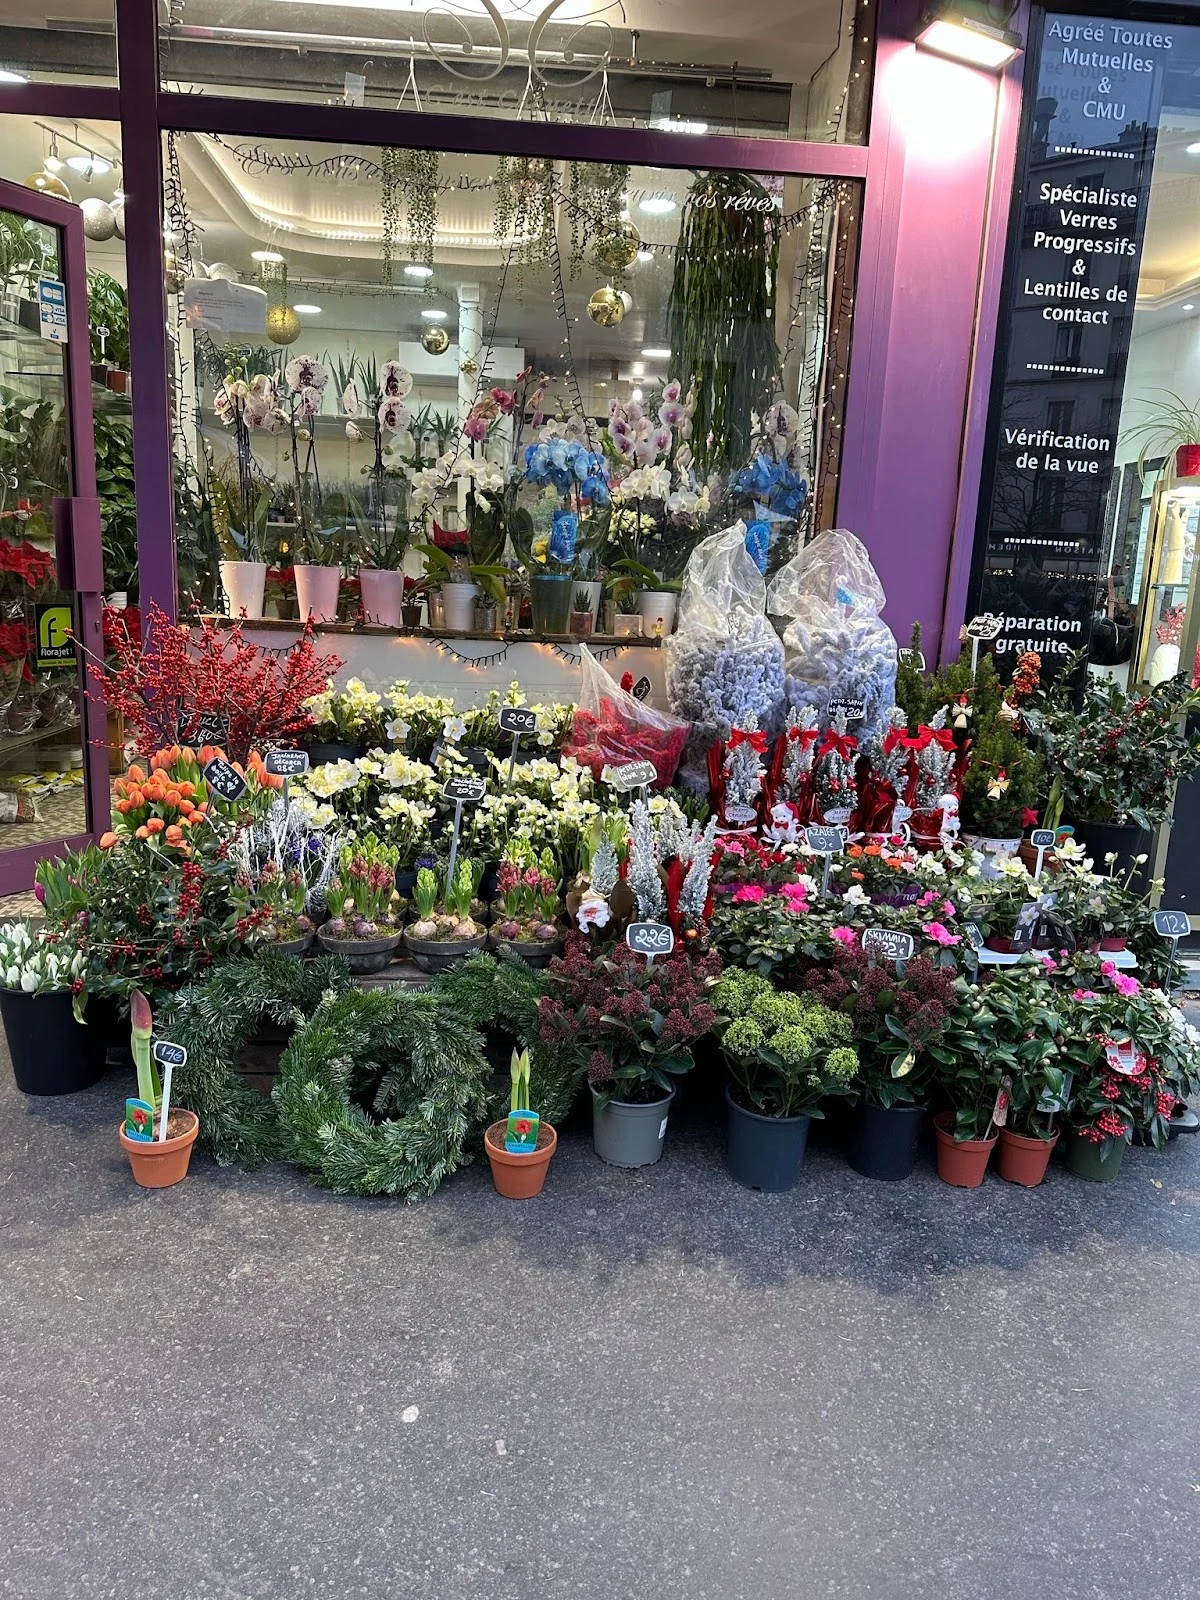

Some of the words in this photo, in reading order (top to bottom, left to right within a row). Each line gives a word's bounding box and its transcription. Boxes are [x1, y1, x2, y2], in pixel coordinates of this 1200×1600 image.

[1048, 20, 1105, 43] Agréé
[1110, 26, 1173, 49] Toutes
[1062, 47, 1154, 73] Mutuelles
[1098, 76, 1112, 94] &
[1083, 101, 1126, 120] CMU
[722, 188, 776, 213] rêves
[1039, 182, 1137, 208] Spécialiste
[1060, 208, 1118, 230] Verres
[1033, 231, 1136, 256] Progressifs
[1072, 258, 1086, 275] &
[1024, 278, 1100, 300] Lentilles
[1105, 285, 1128, 303] de
[1042, 307, 1109, 325] contact
[1004, 428, 1110, 451] Vérification
[1016, 452, 1038, 469] de
[1044, 454, 1060, 471] la
[1067, 459, 1099, 474] vue
[40, 648, 70, 657] florajet
[995, 637, 1068, 654] gratuite
[507, 712, 534, 728] 20€
[1161, 914, 1187, 933] 12€
[635, 928, 670, 948] 22€
[867, 930, 907, 944] SKIMMIA
[161, 1045, 183, 1062] 14€
